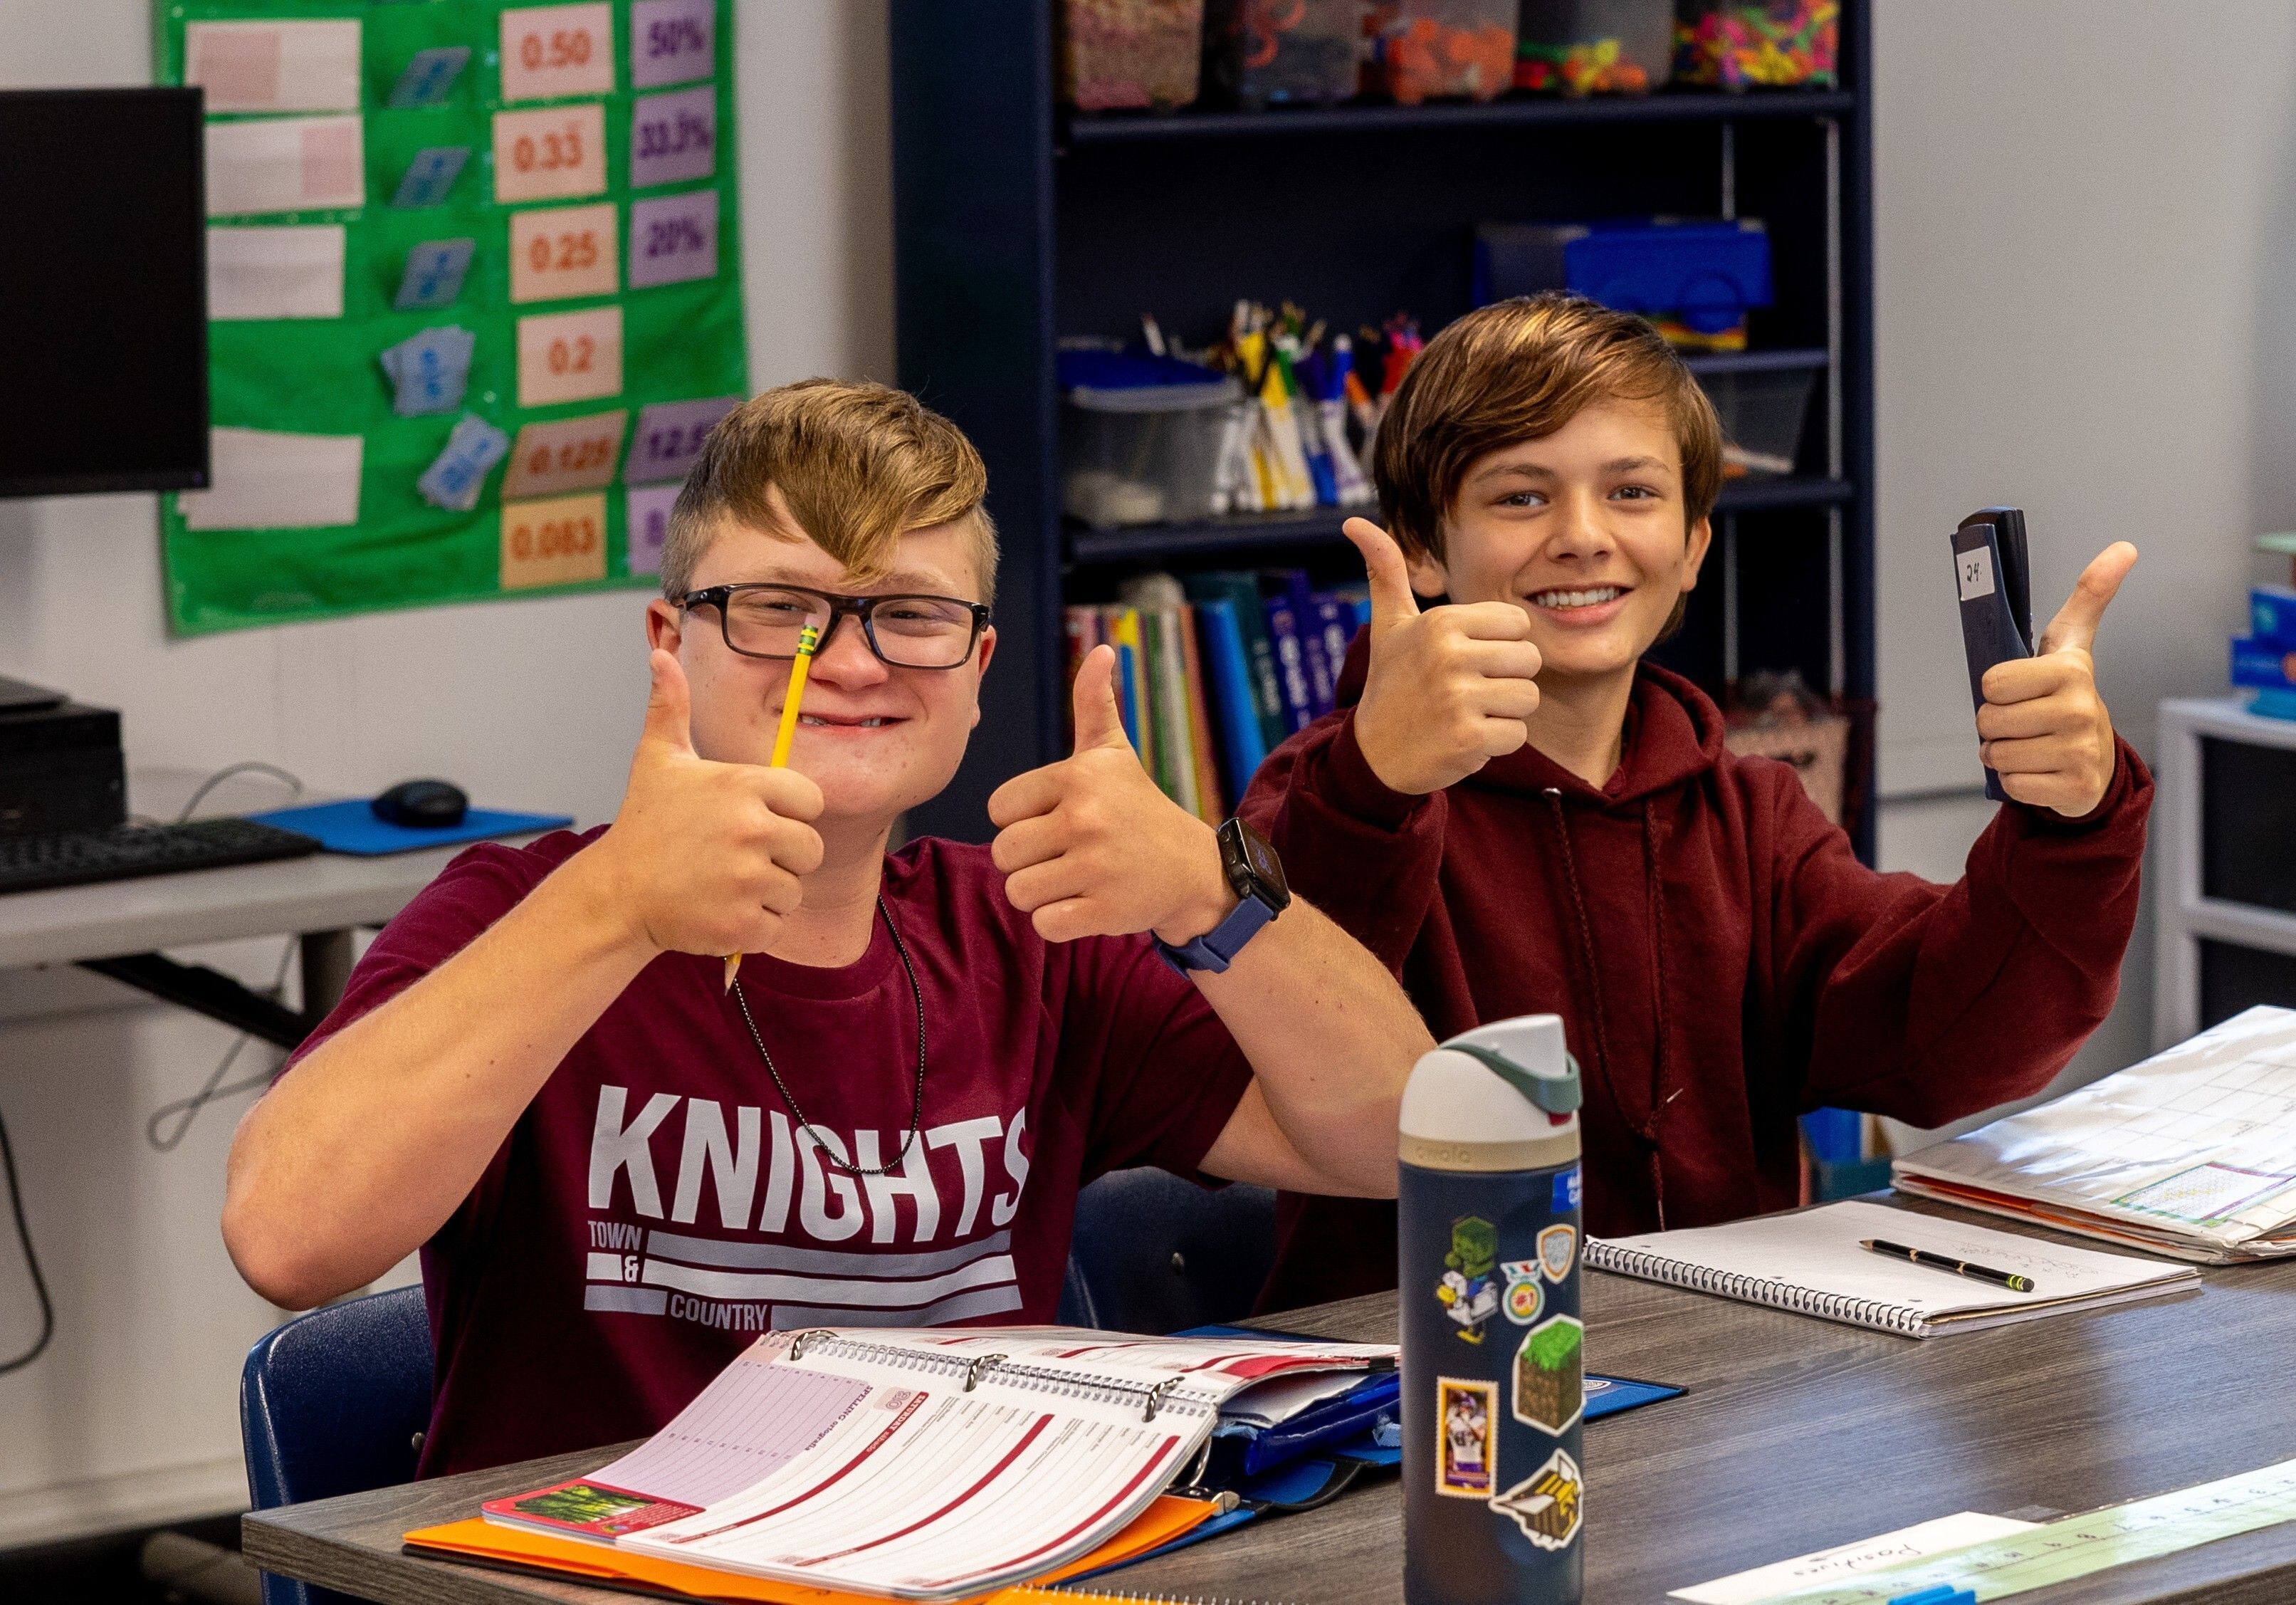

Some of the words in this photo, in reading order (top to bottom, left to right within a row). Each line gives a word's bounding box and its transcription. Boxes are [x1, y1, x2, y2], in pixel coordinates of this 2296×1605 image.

[520, 28, 593, 72] 0.50
[647, 18, 705, 58] 50%
[529, 230, 598, 273] 0.25
[646, 216, 704, 258] 20%
[548, 334, 594, 377] 0.2
[510, 516, 596, 562] 0.083
[588, 1084, 1031, 1243] KNIGHTS
[587, 1220, 642, 1251] TOWN
[624, 1255, 639, 1282] &
[670, 1294, 768, 1331] COUNTRY
[1515, 1290, 1534, 1307] #1
[838, 1385, 874, 1421] SPELLING
[888, 1394, 927, 1432] SATURDAY
